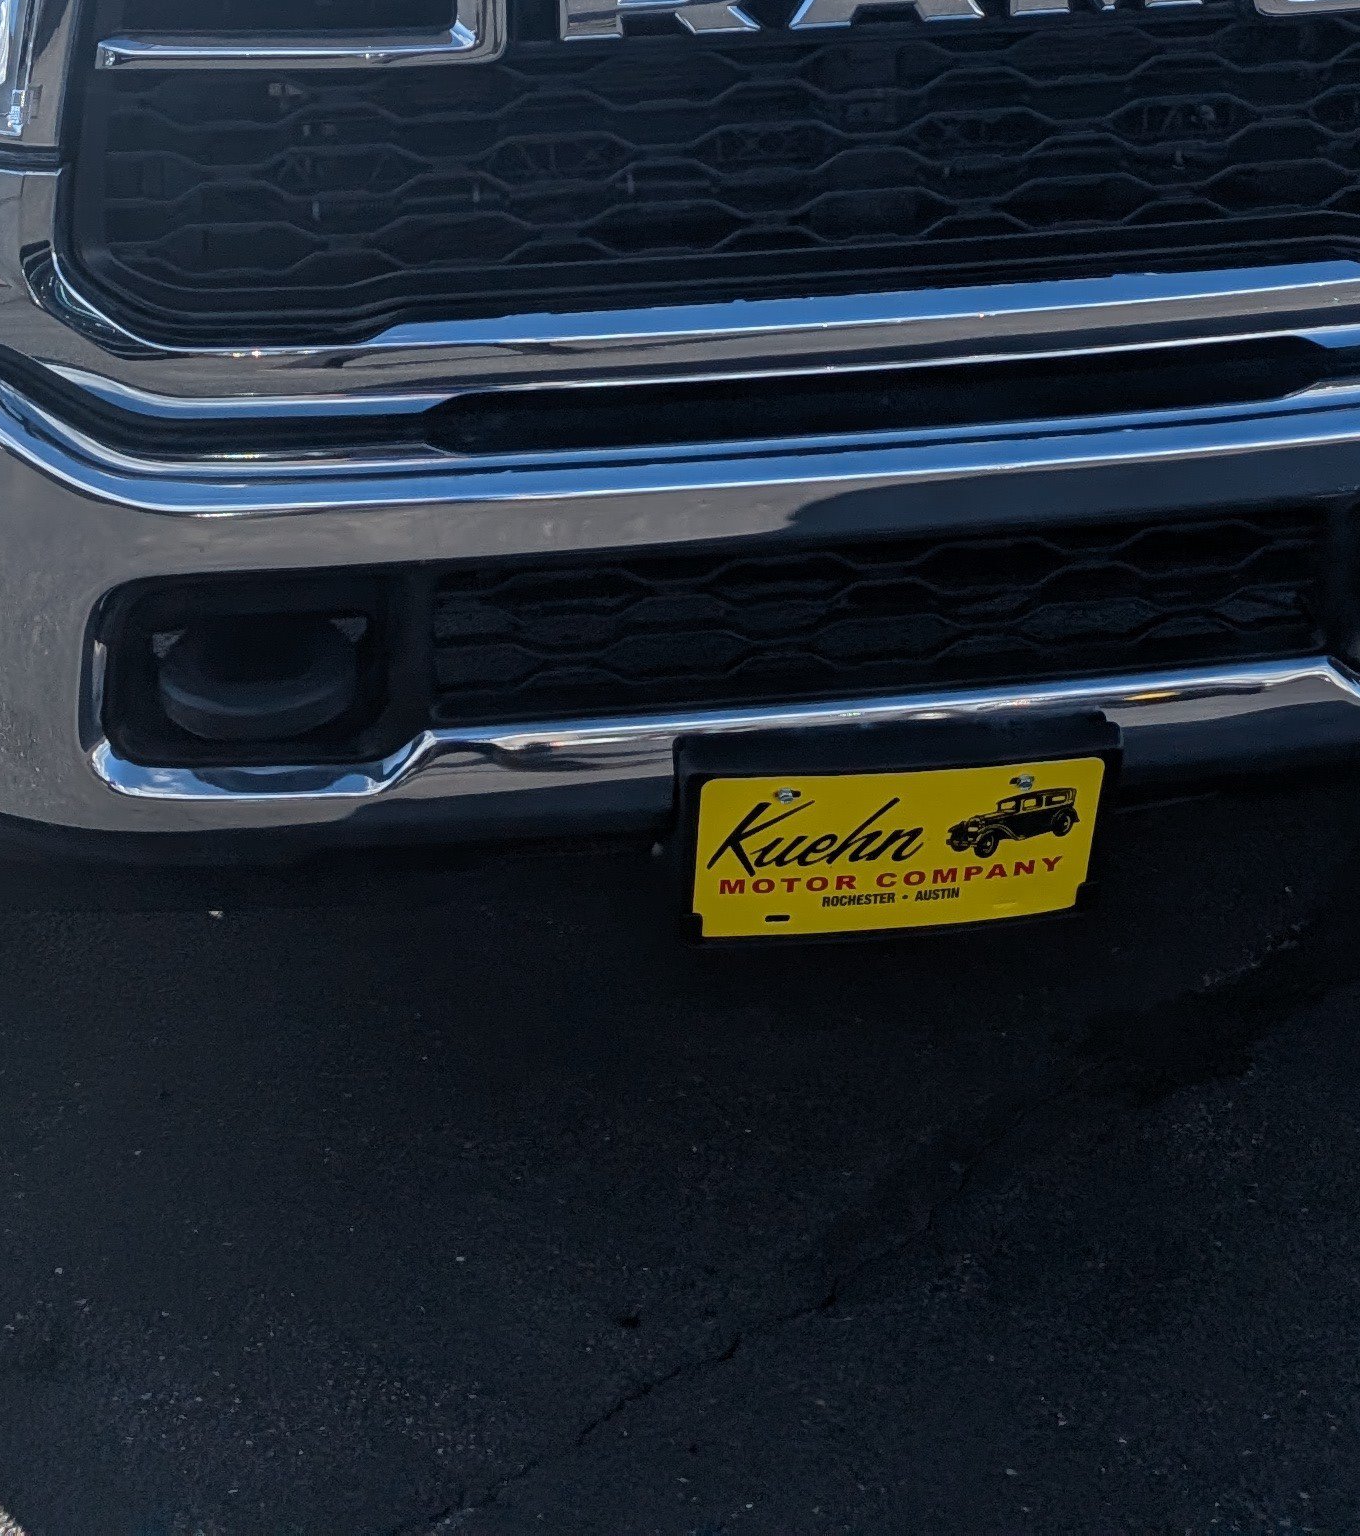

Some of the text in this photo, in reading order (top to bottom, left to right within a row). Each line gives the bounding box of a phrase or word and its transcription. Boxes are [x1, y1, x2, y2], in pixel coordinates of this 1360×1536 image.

[707, 797, 924, 877] Kuehn
[719, 855, 1063, 895] MOTOR COMPANY
[822, 887, 960, 908] ROCHESTER AUSTIN
